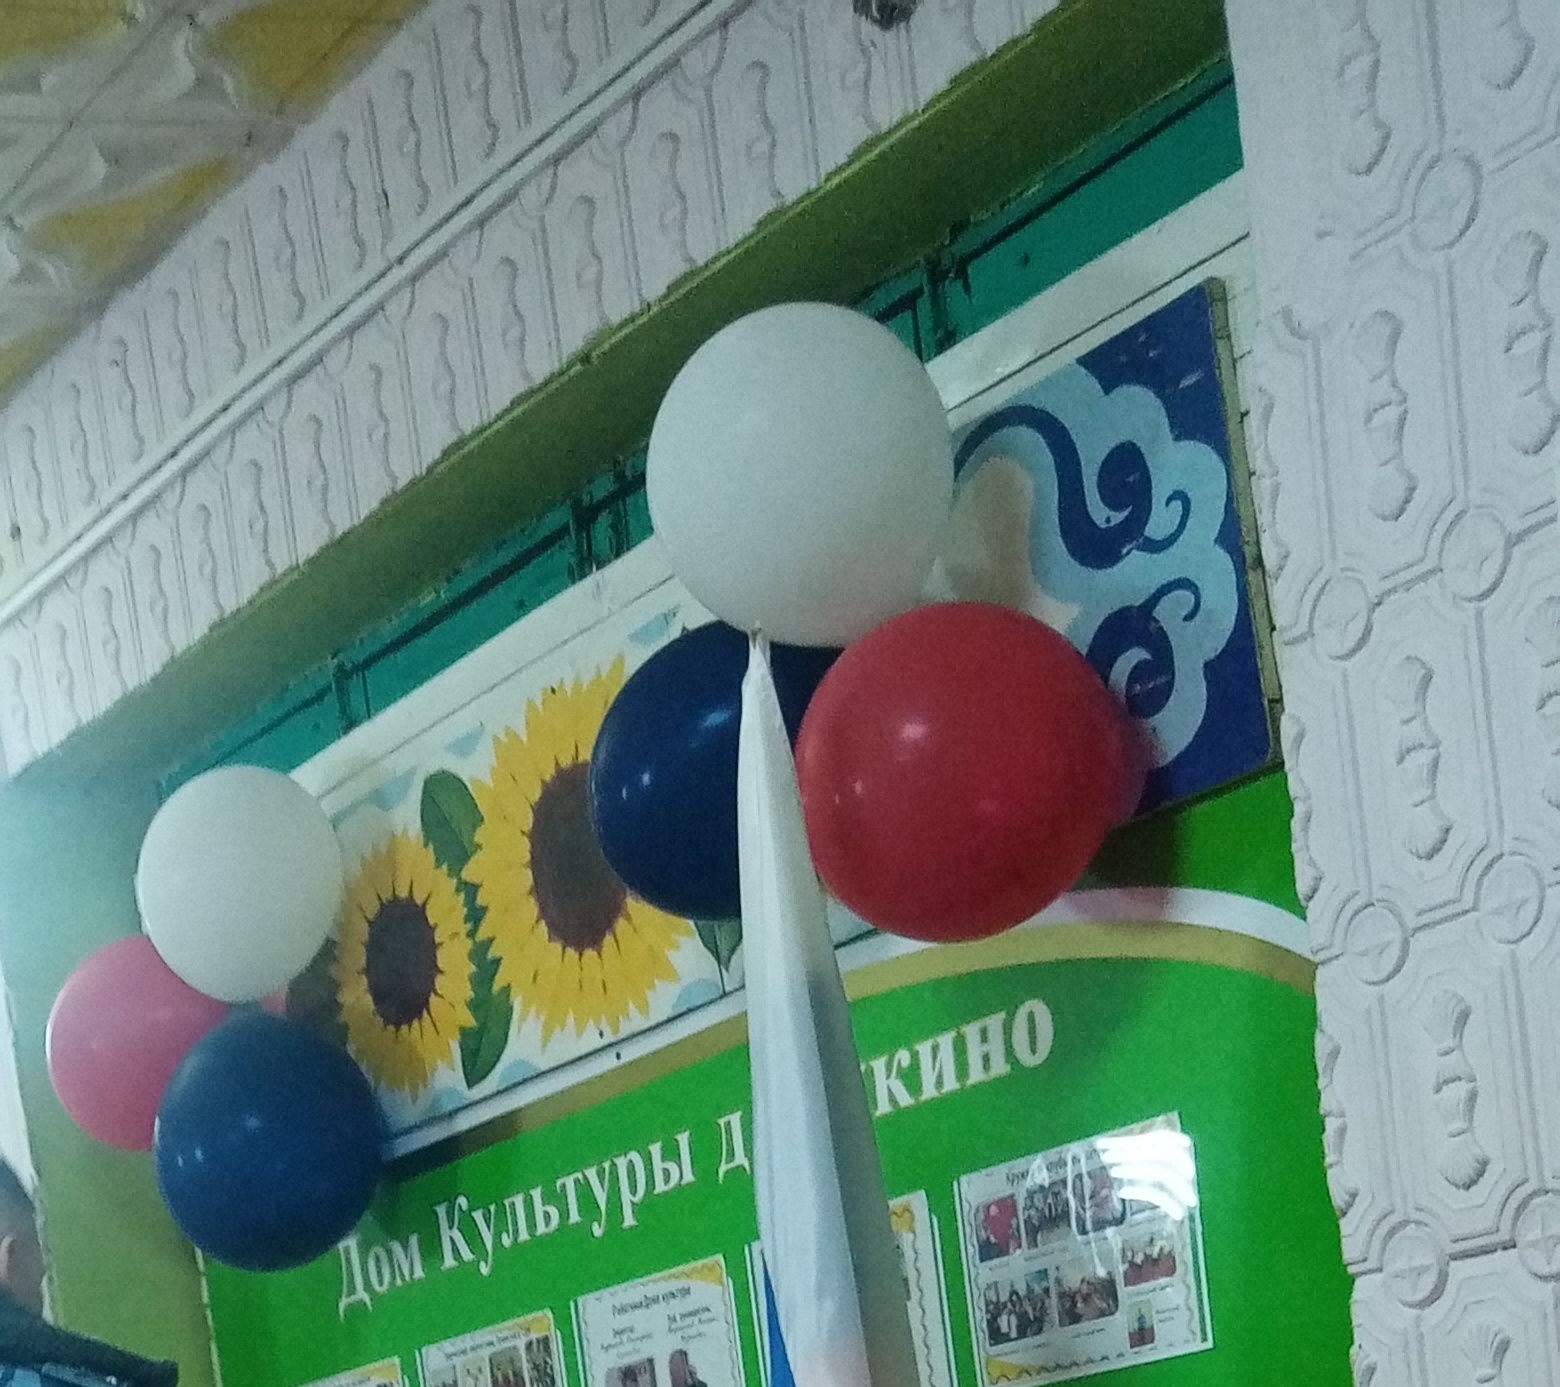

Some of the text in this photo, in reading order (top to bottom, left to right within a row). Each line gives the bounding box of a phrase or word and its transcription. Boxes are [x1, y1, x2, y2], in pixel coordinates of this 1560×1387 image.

[337, 1233, 426, 1323] Дом
[435, 1129, 696, 1278] Культуры
[860, 998, 1054, 1117] кино
